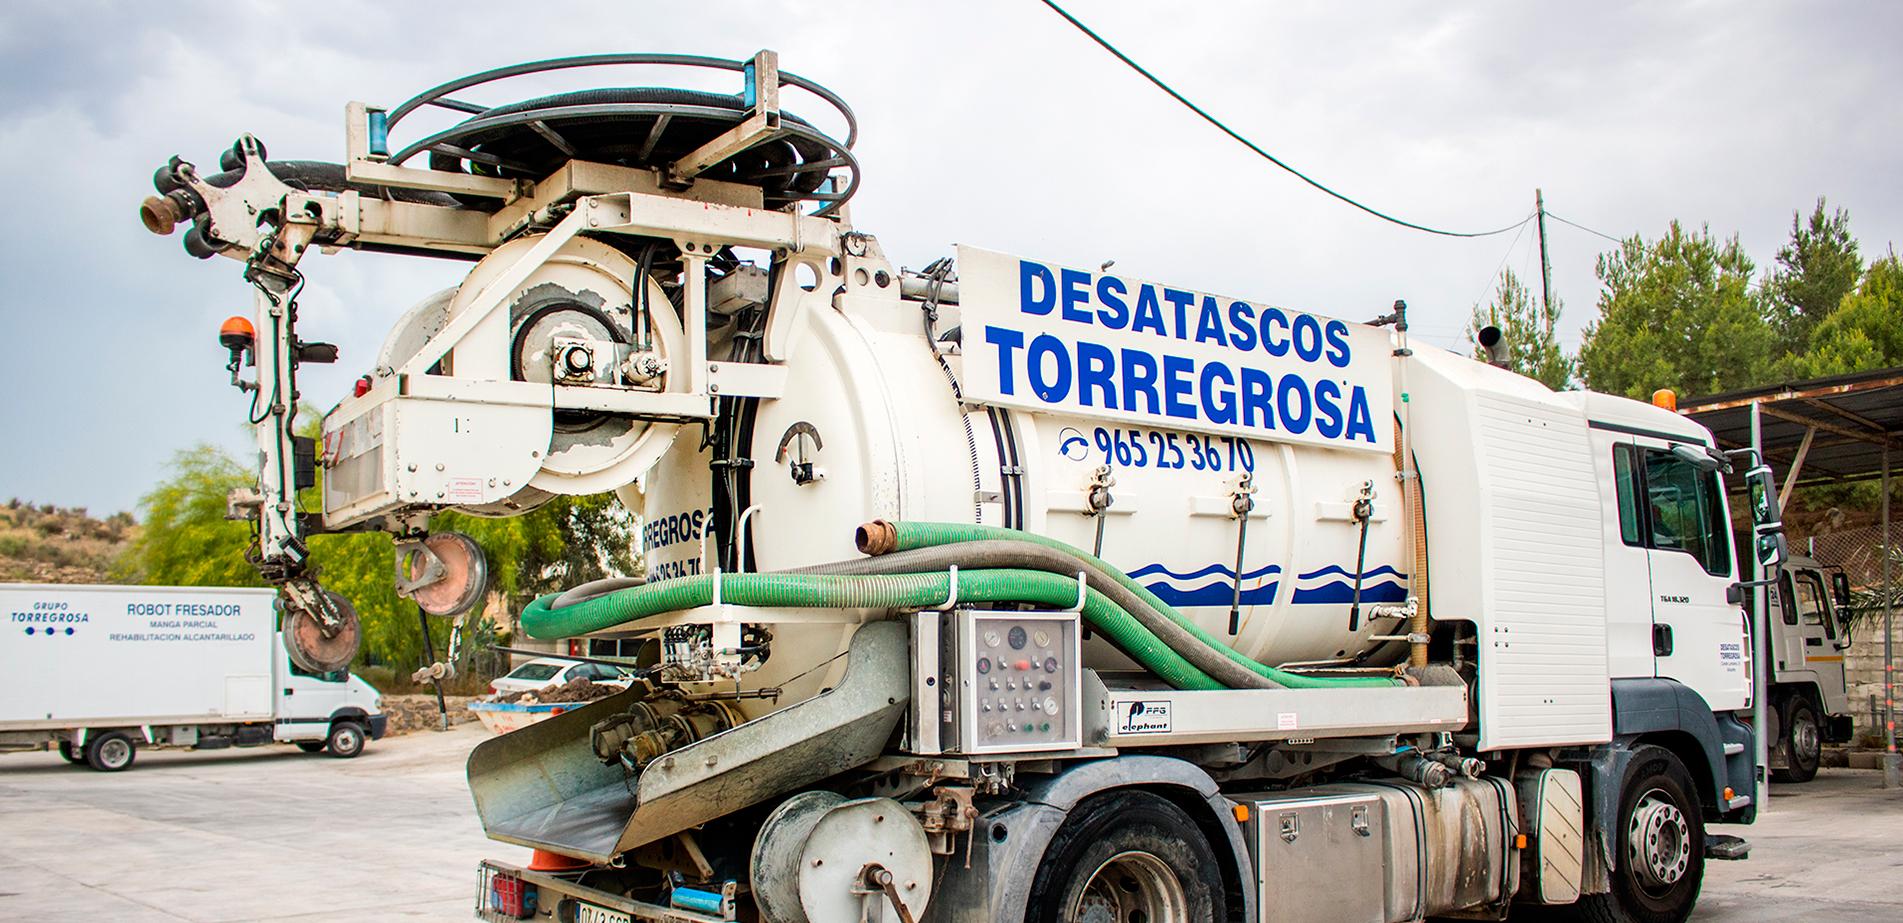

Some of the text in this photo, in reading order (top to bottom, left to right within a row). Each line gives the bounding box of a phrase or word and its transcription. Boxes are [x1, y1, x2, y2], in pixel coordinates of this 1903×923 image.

[1020, 260, 1351, 368] DESATASCOS
[985, 326, 1377, 443] TORREGROSA
[1094, 427, 1255, 473] 965 25 36 70
[33, 601, 68, 611] GRUPO
[127, 603, 241, 616] ROBOT FRESADOR
[11, 612, 89, 623] TORREGROSA
[150, 620, 218, 628] MANGA PARCIAL
[110, 633, 255, 641] REHABILITACION ALCANTARILLADO
